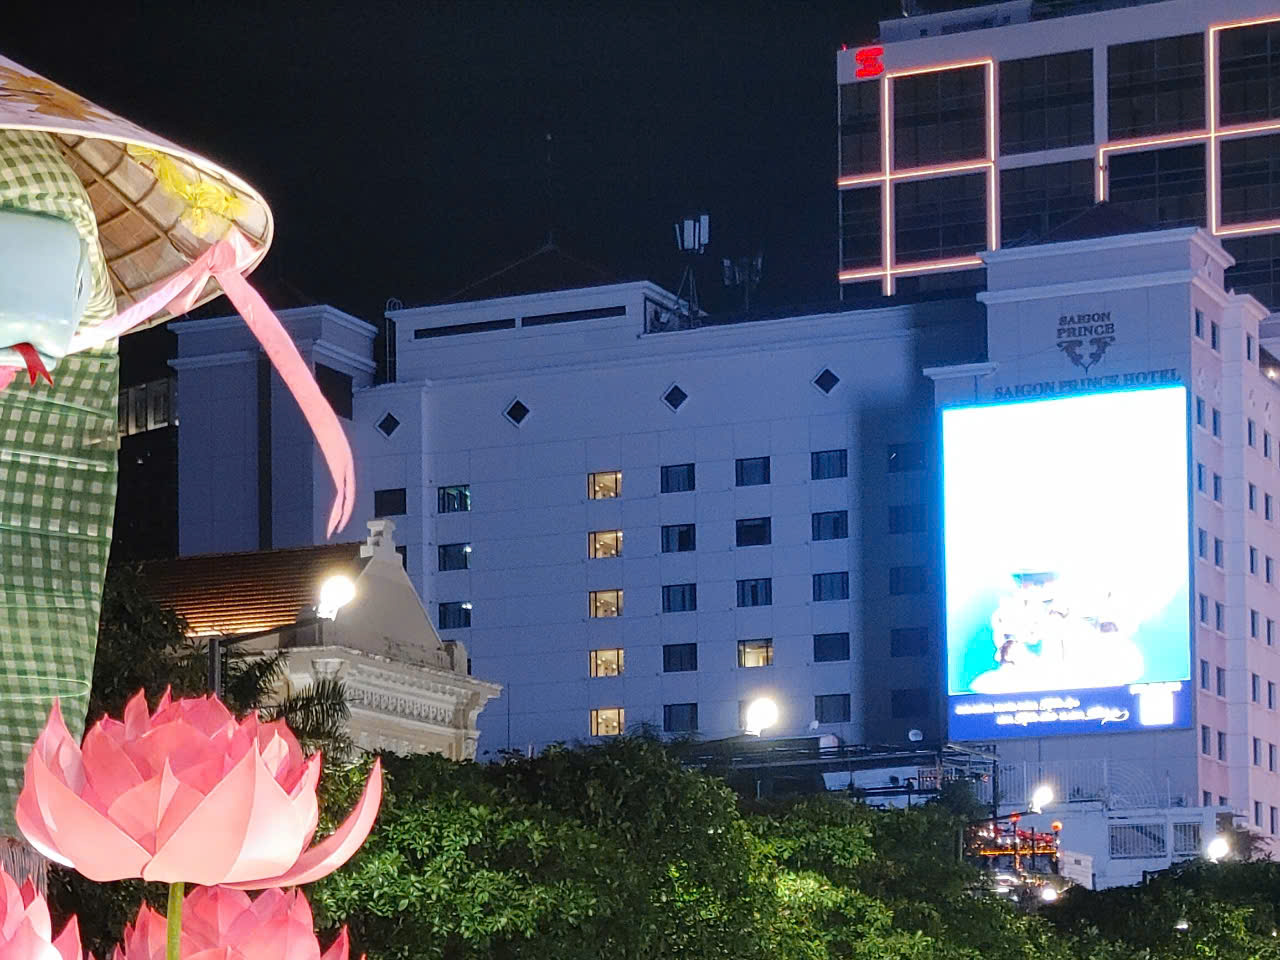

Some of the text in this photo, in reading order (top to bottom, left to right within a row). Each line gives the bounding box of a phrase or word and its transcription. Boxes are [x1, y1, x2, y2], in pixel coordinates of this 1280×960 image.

[1059, 312, 1111, 326] SAIGON
[1057, 323, 1114, 338] PRINCE
[994, 368, 1182, 399] SAIGON PRINCE HOTEL
